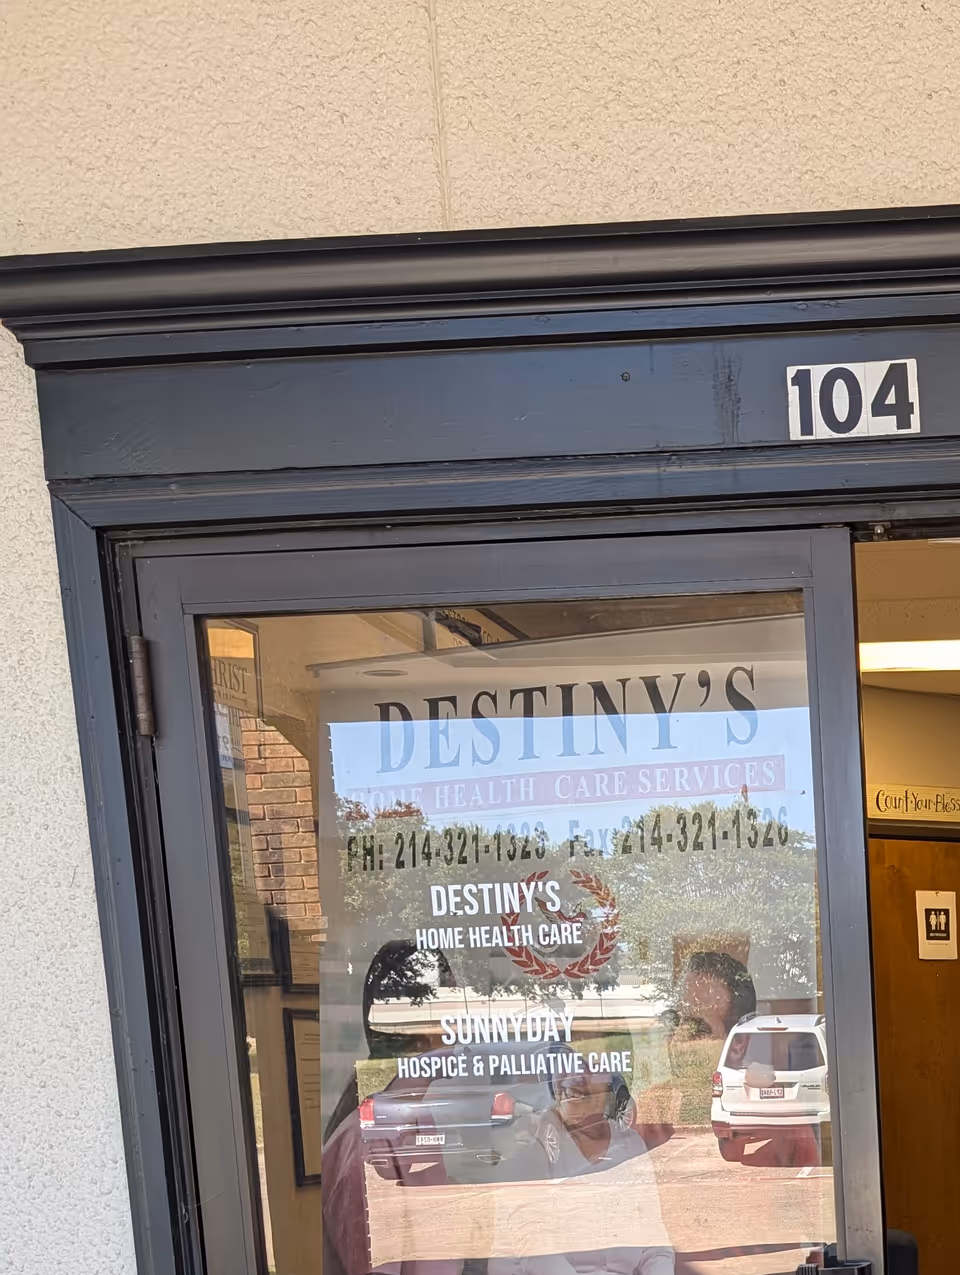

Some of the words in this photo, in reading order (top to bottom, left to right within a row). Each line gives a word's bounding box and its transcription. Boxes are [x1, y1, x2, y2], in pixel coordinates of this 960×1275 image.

[791, 362, 914, 436] 104
[374, 665, 759, 774] DESTINY'S
[435, 777, 536, 809] HEALTH
[554, 770, 628, 800] CARE
[638, 760, 776, 795] SERVICES
[347, 834, 384, 872] PH:
[430, 880, 561, 916] DESTINY'S
[415, 927, 464, 949] HOME
[469, 924, 534, 948] HEALTH
[538, 923, 583, 944] CARE
[440, 1012, 574, 1045] SUNNYDAY
[397, 1055, 468, 1078] HOSPICE
[473, 1056, 484, 1076] &
[489, 1053, 583, 1075] PALLIATIVE
[588, 1051, 632, 1073] CARE
